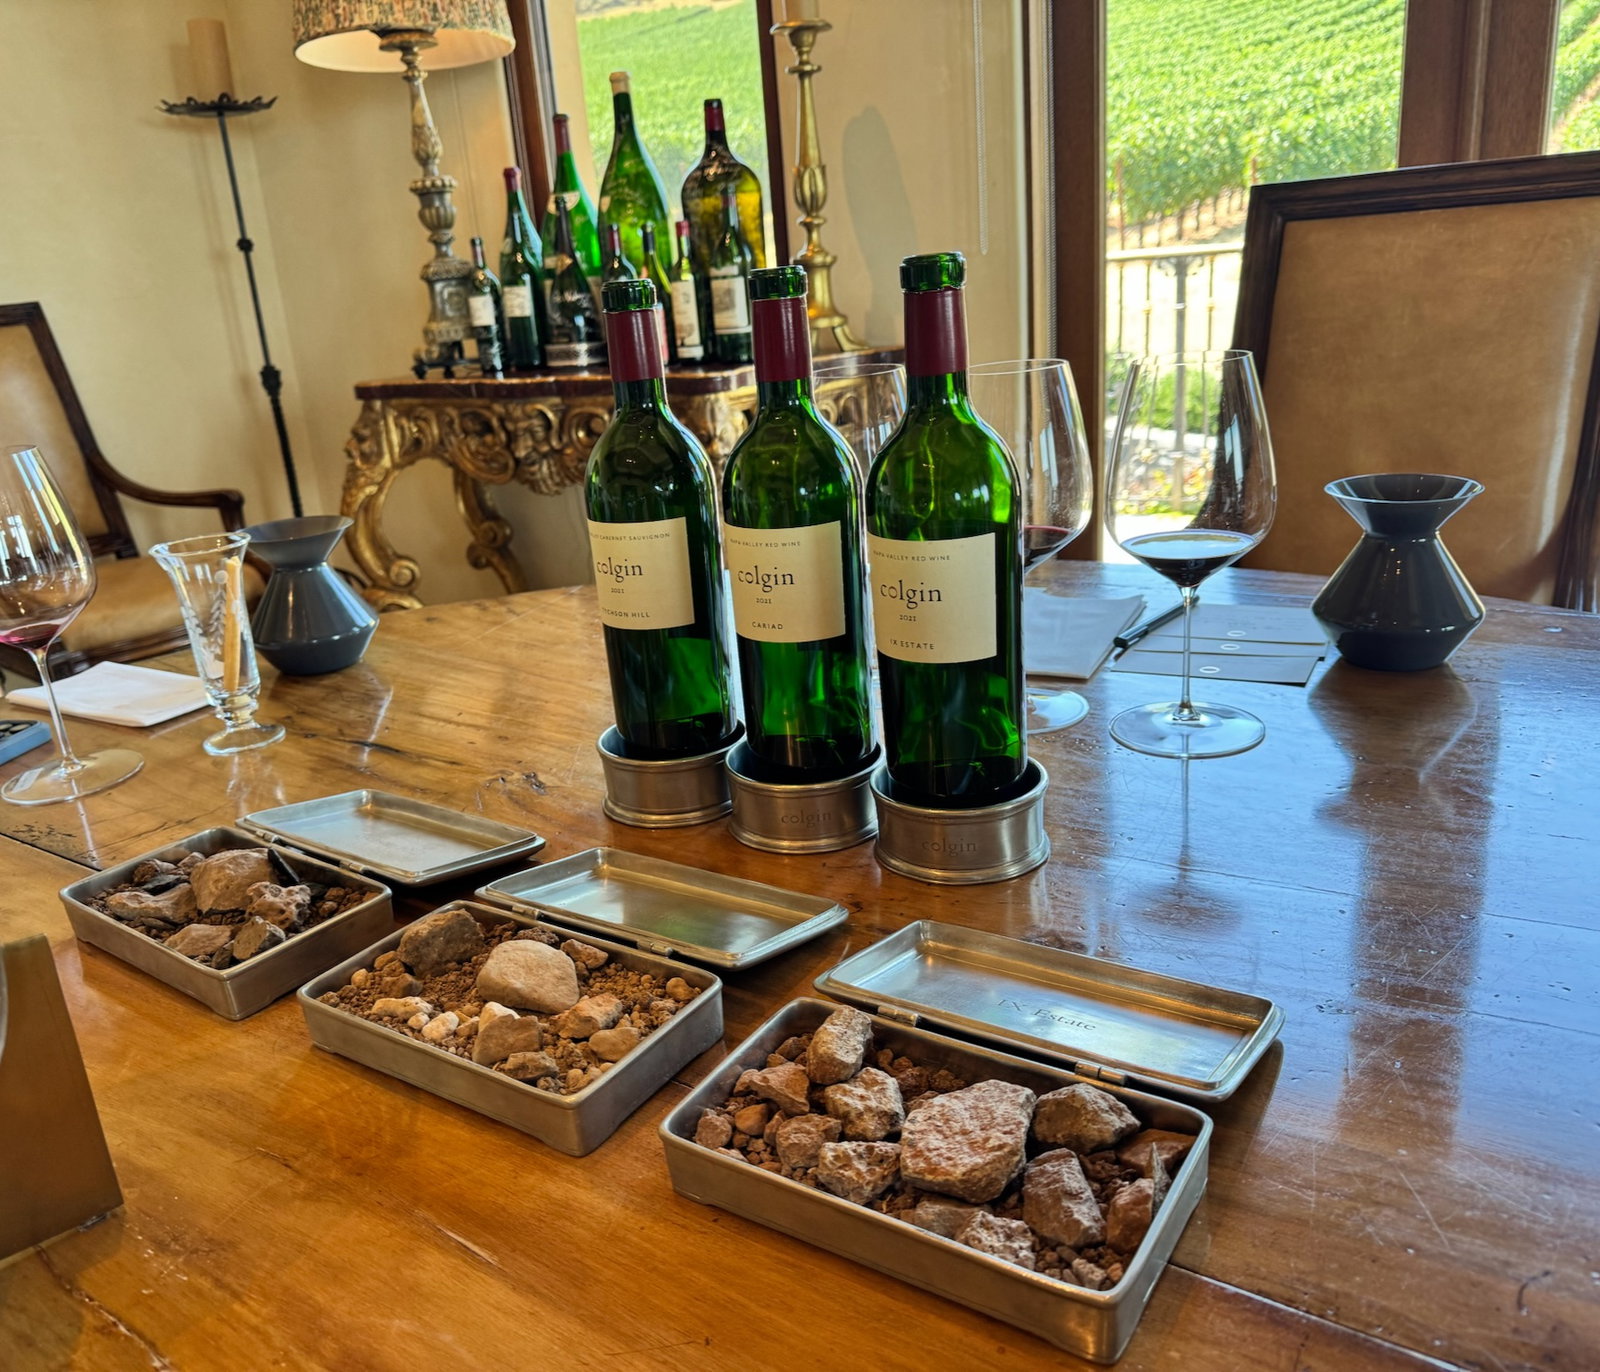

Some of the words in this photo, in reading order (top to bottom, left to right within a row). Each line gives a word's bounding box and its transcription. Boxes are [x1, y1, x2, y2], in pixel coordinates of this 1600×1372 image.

[629, 532, 670, 541] SAUVIGNON
[886, 553, 909, 561] VALLEY
[596, 556, 643, 583] colgin
[737, 565, 795, 593] colgin
[880, 579, 942, 610] colgin
[751, 621, 784, 630] CARIAD
[899, 614, 917, 622] 2021
[900, 640, 935, 650] ESTATE
[780, 809, 832, 828] colgin
[921, 837, 977, 857] colgin
[1033, 1009, 1096, 1031] Estate
